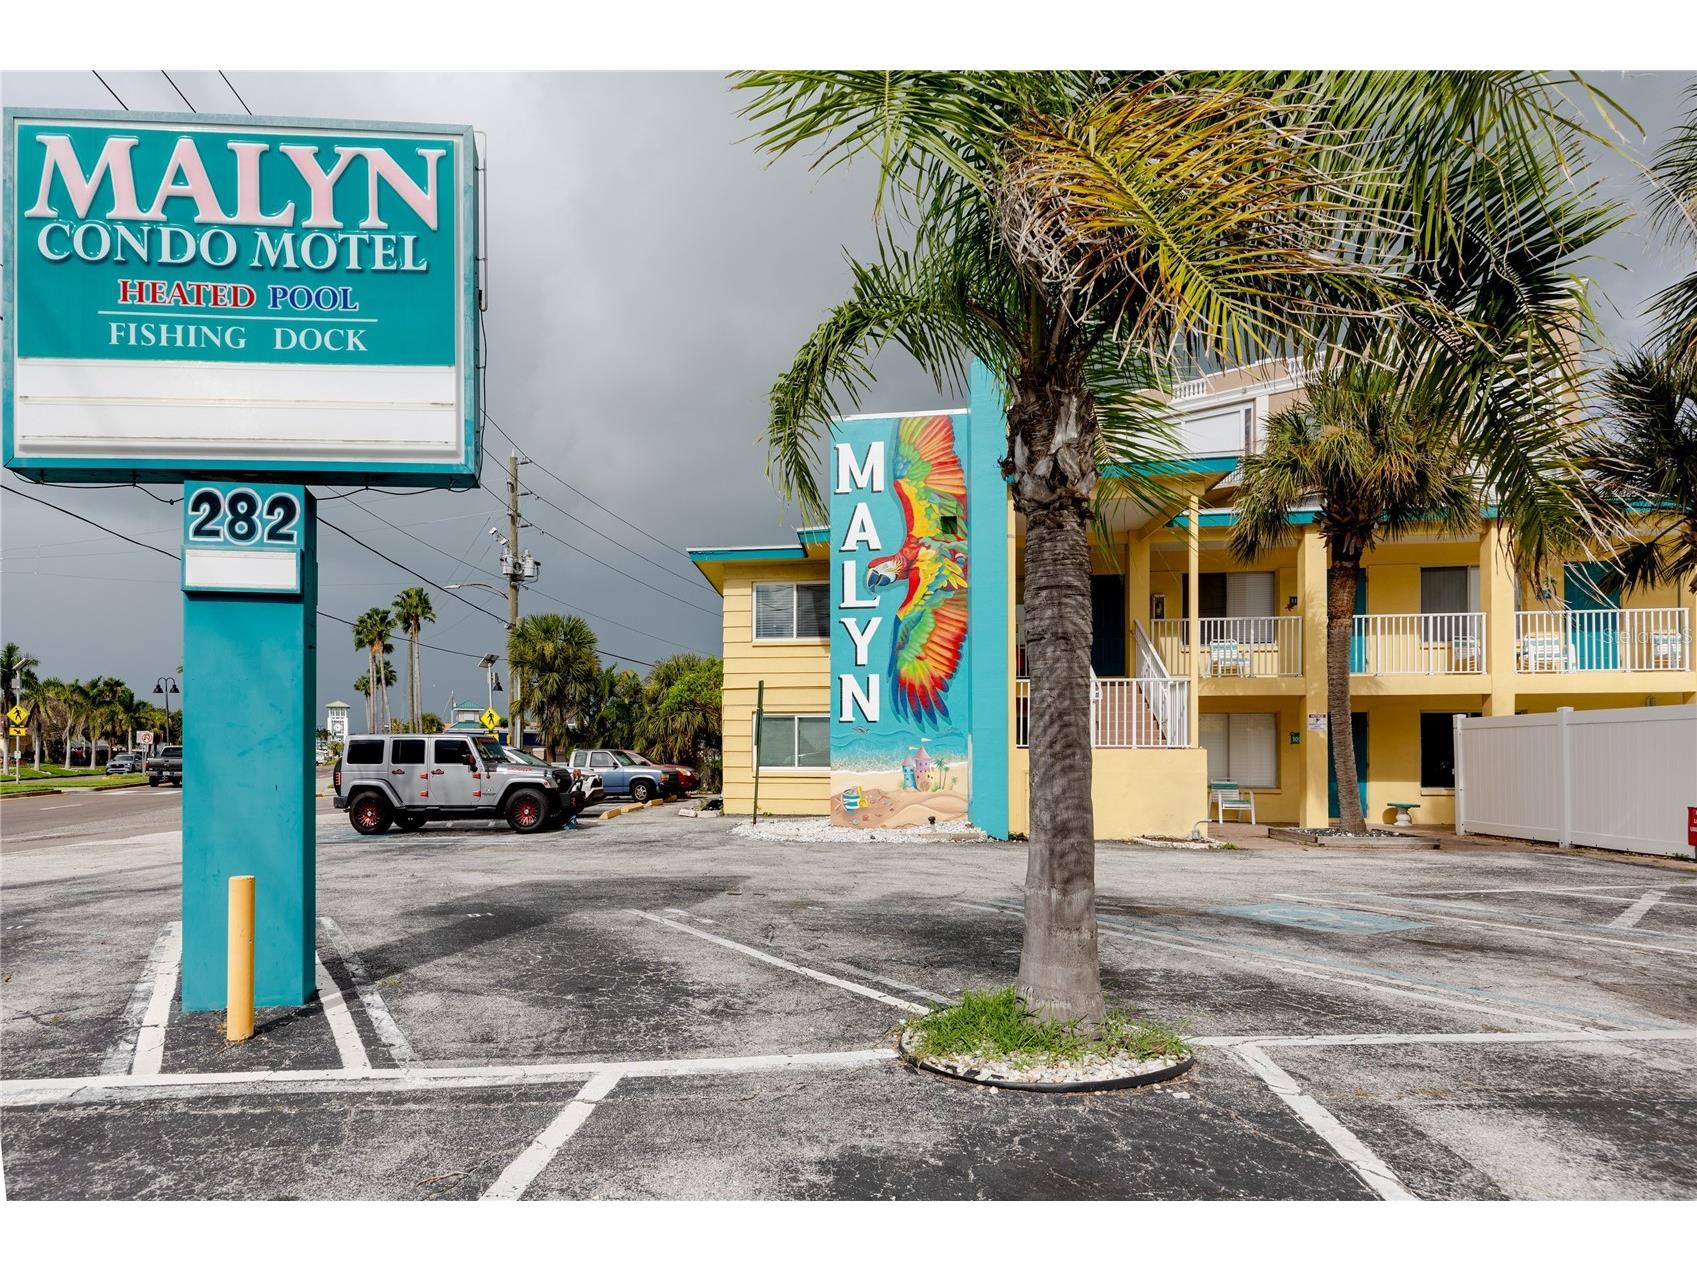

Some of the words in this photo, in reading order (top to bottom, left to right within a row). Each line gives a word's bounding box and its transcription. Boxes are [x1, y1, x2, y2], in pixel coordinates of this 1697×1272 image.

[24, 132, 447, 232] MALYN
[37, 223, 238, 267] CONDO
[249, 231, 429, 272] MOTEL
[118, 279, 256, 309] HEATED
[268, 284, 359, 311] POOL
[108, 322, 248, 350] FISHING
[273, 326, 368, 352] DOCK
[188, 487, 300, 546] 282
[834, 440, 885, 723] MALYN
